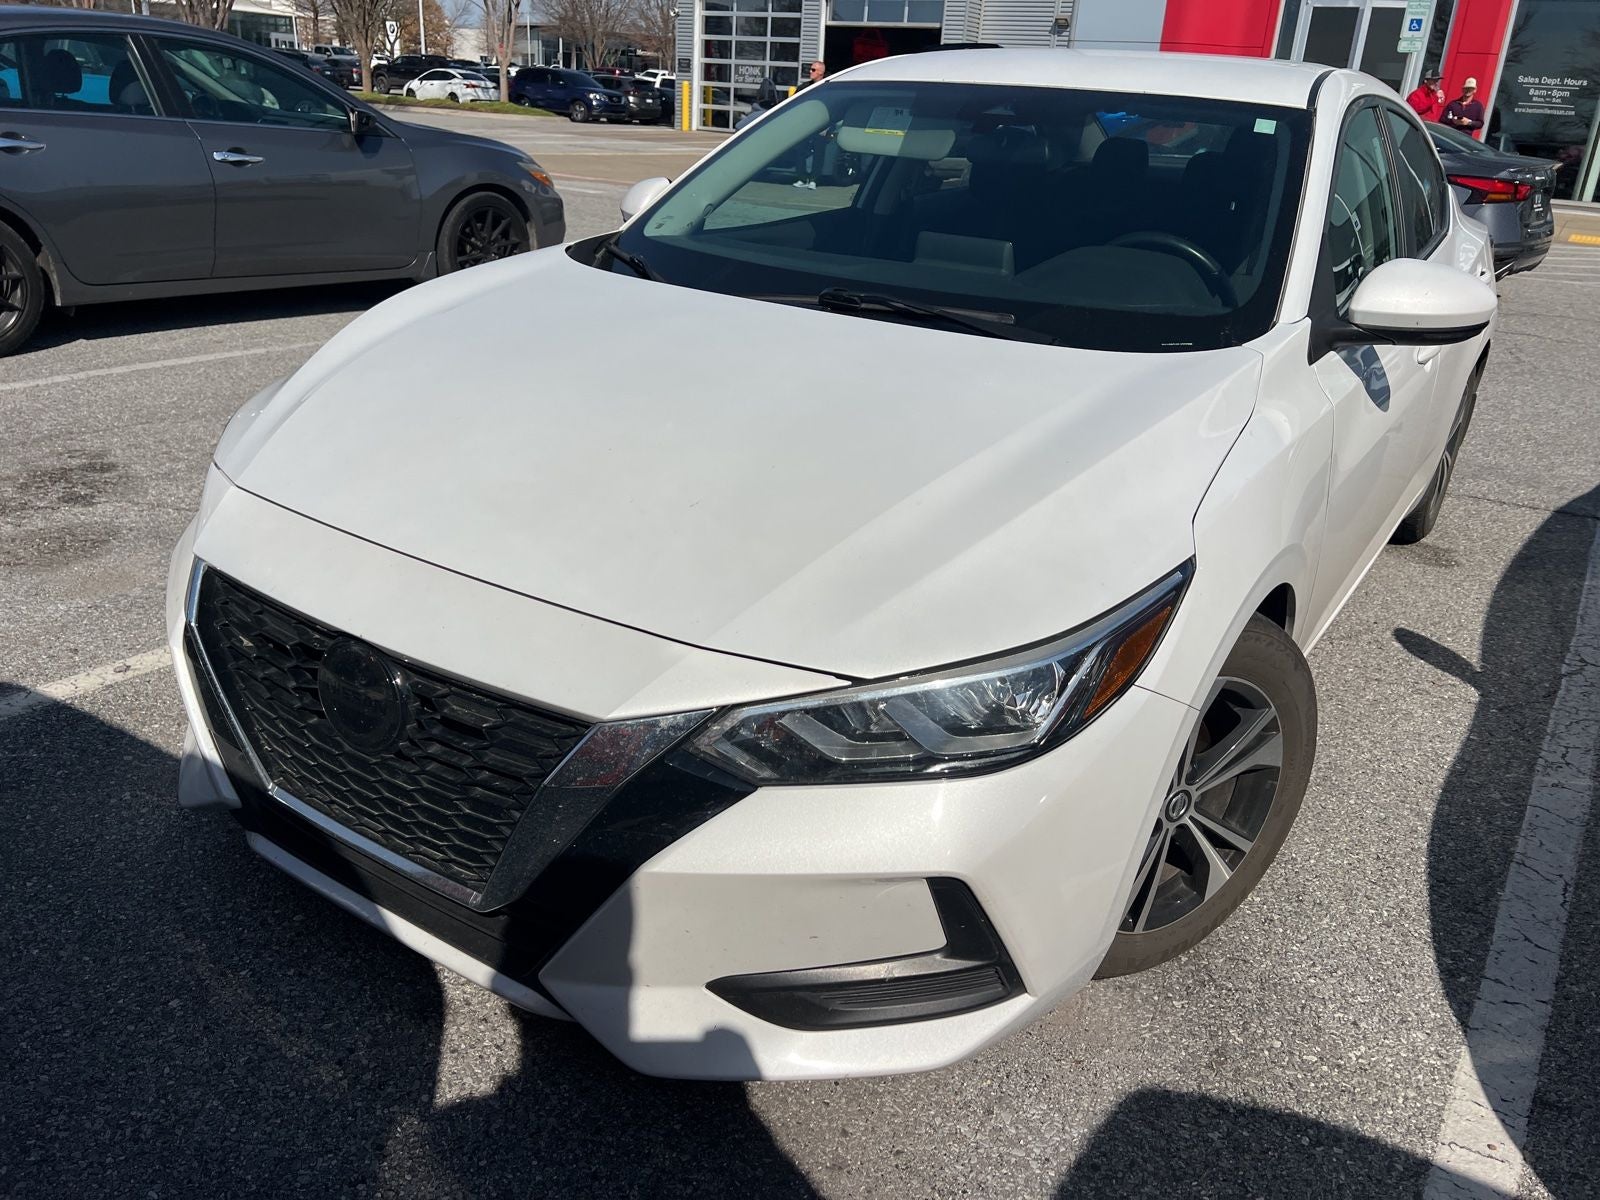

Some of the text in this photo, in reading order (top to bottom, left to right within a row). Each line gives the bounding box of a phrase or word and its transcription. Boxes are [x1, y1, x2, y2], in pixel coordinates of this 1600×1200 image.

[739, 65, 761, 75] HONK
[745, 75, 763, 83] Servic
[1518, 75, 1588, 86] Sales Dept. Hours
